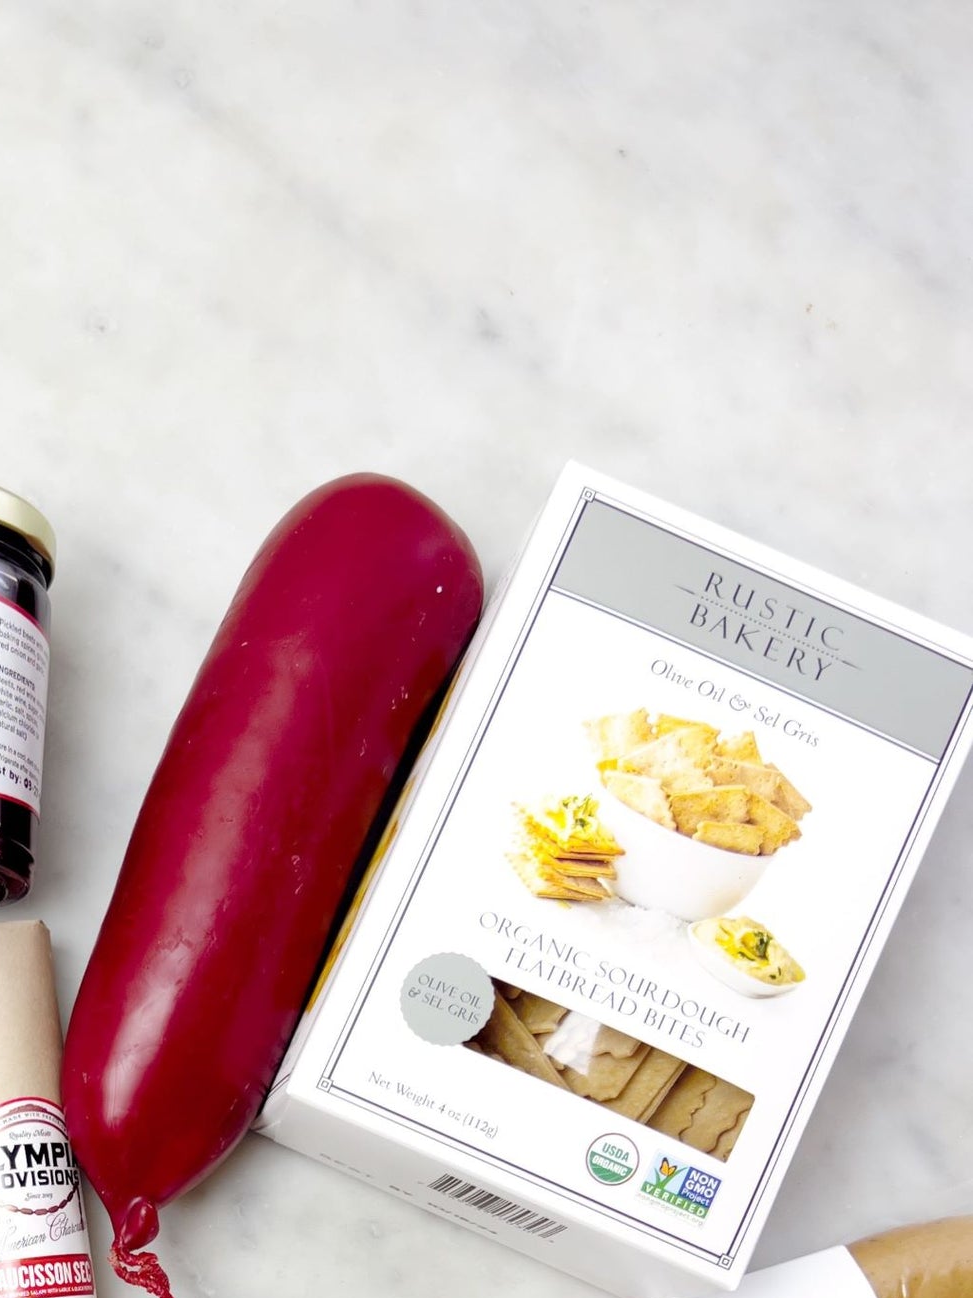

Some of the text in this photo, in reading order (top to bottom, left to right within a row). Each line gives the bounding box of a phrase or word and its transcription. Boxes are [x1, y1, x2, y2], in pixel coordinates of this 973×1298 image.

[704, 572, 845, 651] RUSTIC
[690, 603, 832, 681] BAKERY
[651, 659, 820, 748] Olive Oil & Sel Gris
[417, 972, 482, 1010] OLIVE OIL
[478, 910, 752, 1044] ORGANIC SOURDOUGH
[407, 986, 482, 1025] & SEL GRIS
[504, 947, 708, 1049] FLATBREAD BITES
[368, 1070, 500, 1139] Net Weight 4 oz (112g)
[592, 1155, 627, 1176] ORGANIC
[602, 1142, 629, 1162] USDA
[681, 1189, 709, 1206] Project
[685, 1180, 714, 1199] GMO
[689, 1170, 719, 1190] NON
[645, 1184, 705, 1217] VERIFIED
[72, 1262, 91, 1283] SEC
